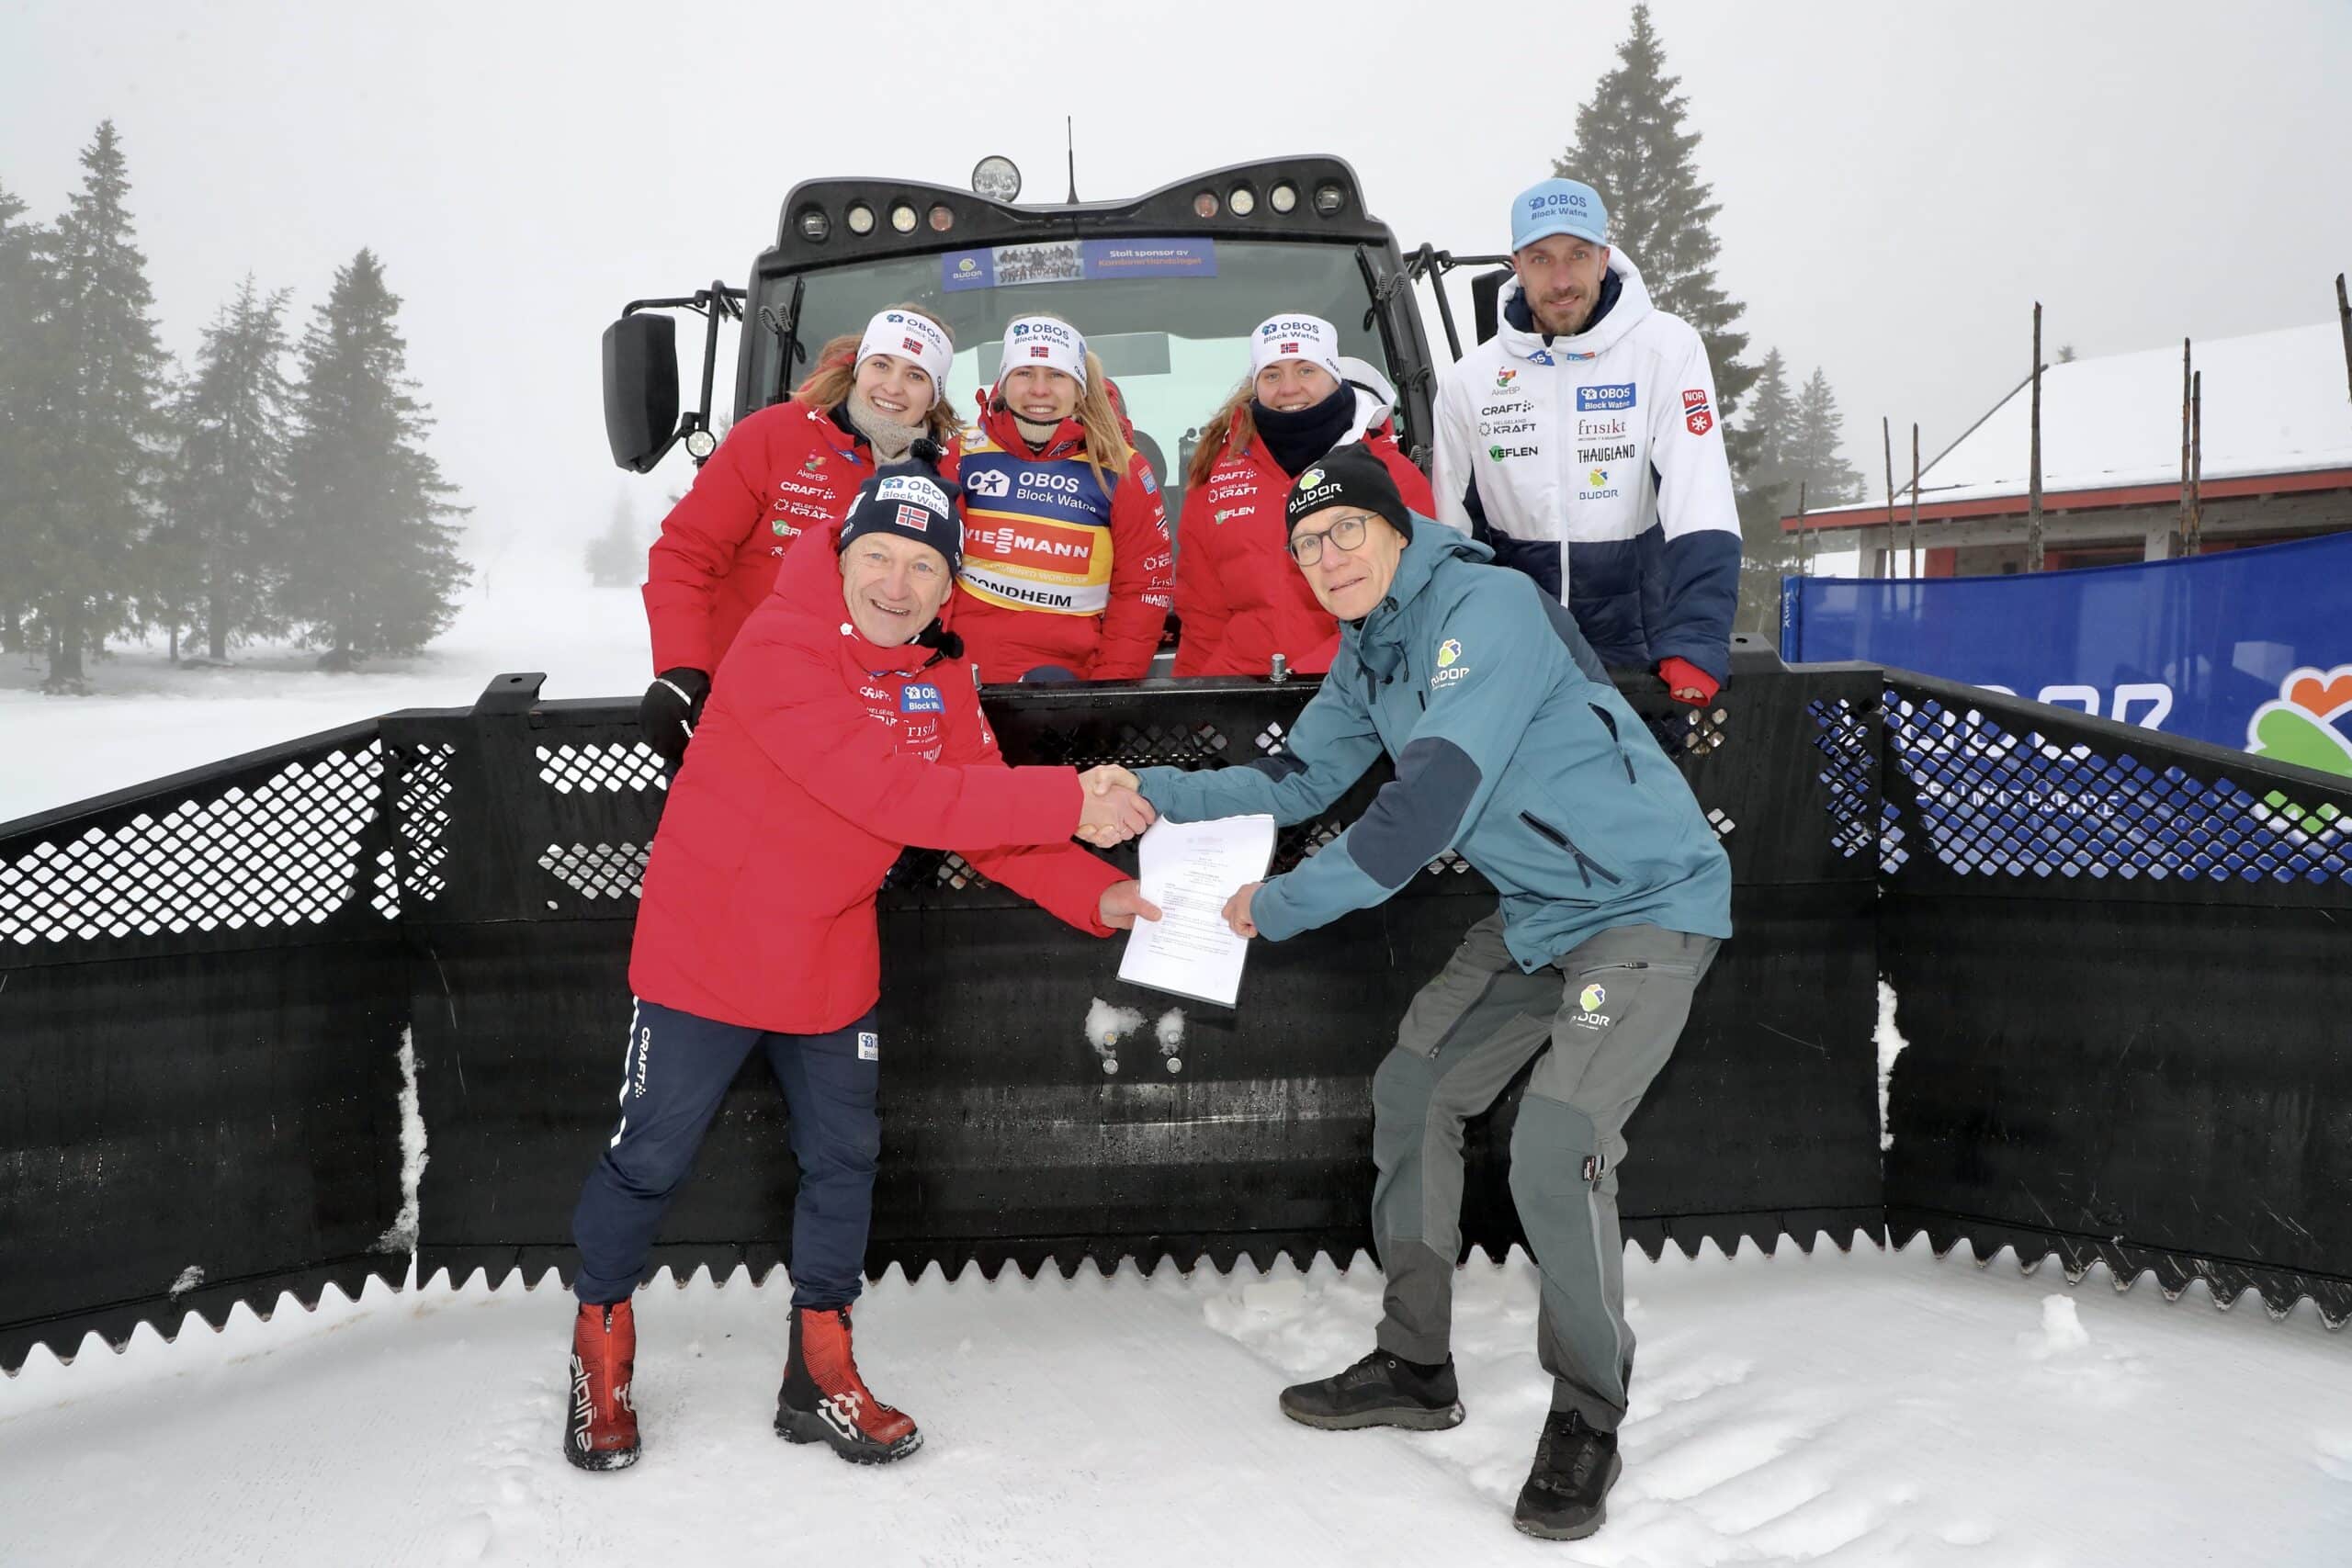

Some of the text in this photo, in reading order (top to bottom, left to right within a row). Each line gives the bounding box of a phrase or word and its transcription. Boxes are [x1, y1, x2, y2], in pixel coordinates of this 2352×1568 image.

[1548, 194, 1588, 208] OBOS
[1532, 208, 1588, 220] Block Watne
[1110, 249, 1133, 257] Stolt
[1135, 249, 1175, 258] sponsor
[907, 319, 941, 344] OBOS
[1032, 323, 1069, 341] OBOS
[1281, 322, 1319, 334] OBOS
[1014, 334, 1070, 349] Block Watne
[1263, 332, 1320, 344] Block Watne
[1599, 387, 1631, 400] OBOS
[1684, 391, 1705, 401] NOR
[1481, 402, 1522, 416] CRAFT
[1585, 400, 1607, 411] Block
[1493, 423, 1537, 434] KRAFT
[1577, 418, 1626, 435] frisikt
[1488, 446, 1539, 459] VEFLEN
[1577, 444, 1635, 464] THAUGLAND
[1018, 470, 1080, 494] OBOS
[1210, 470, 1247, 484] CRAFT
[780, 481, 826, 497] CRAFT
[909, 480, 948, 508] OBOS
[1219, 487, 1258, 499] KRAFT
[1579, 489, 1619, 501] BUDOR
[882, 491, 948, 517] Block Watne
[1016, 488, 1097, 513] Block Watne
[1288, 483, 1343, 513] BUDOR
[1214, 506, 1256, 524] VEFLEN
[965, 527, 1090, 558] VIESSMANN
[961, 572, 1072, 607] ONDHEIM
[922, 687, 938, 699] OB
[909, 702, 931, 710] Block
[1570, 1012, 1611, 1027] DOR
[636, 1026, 650, 1085] CRAFT
